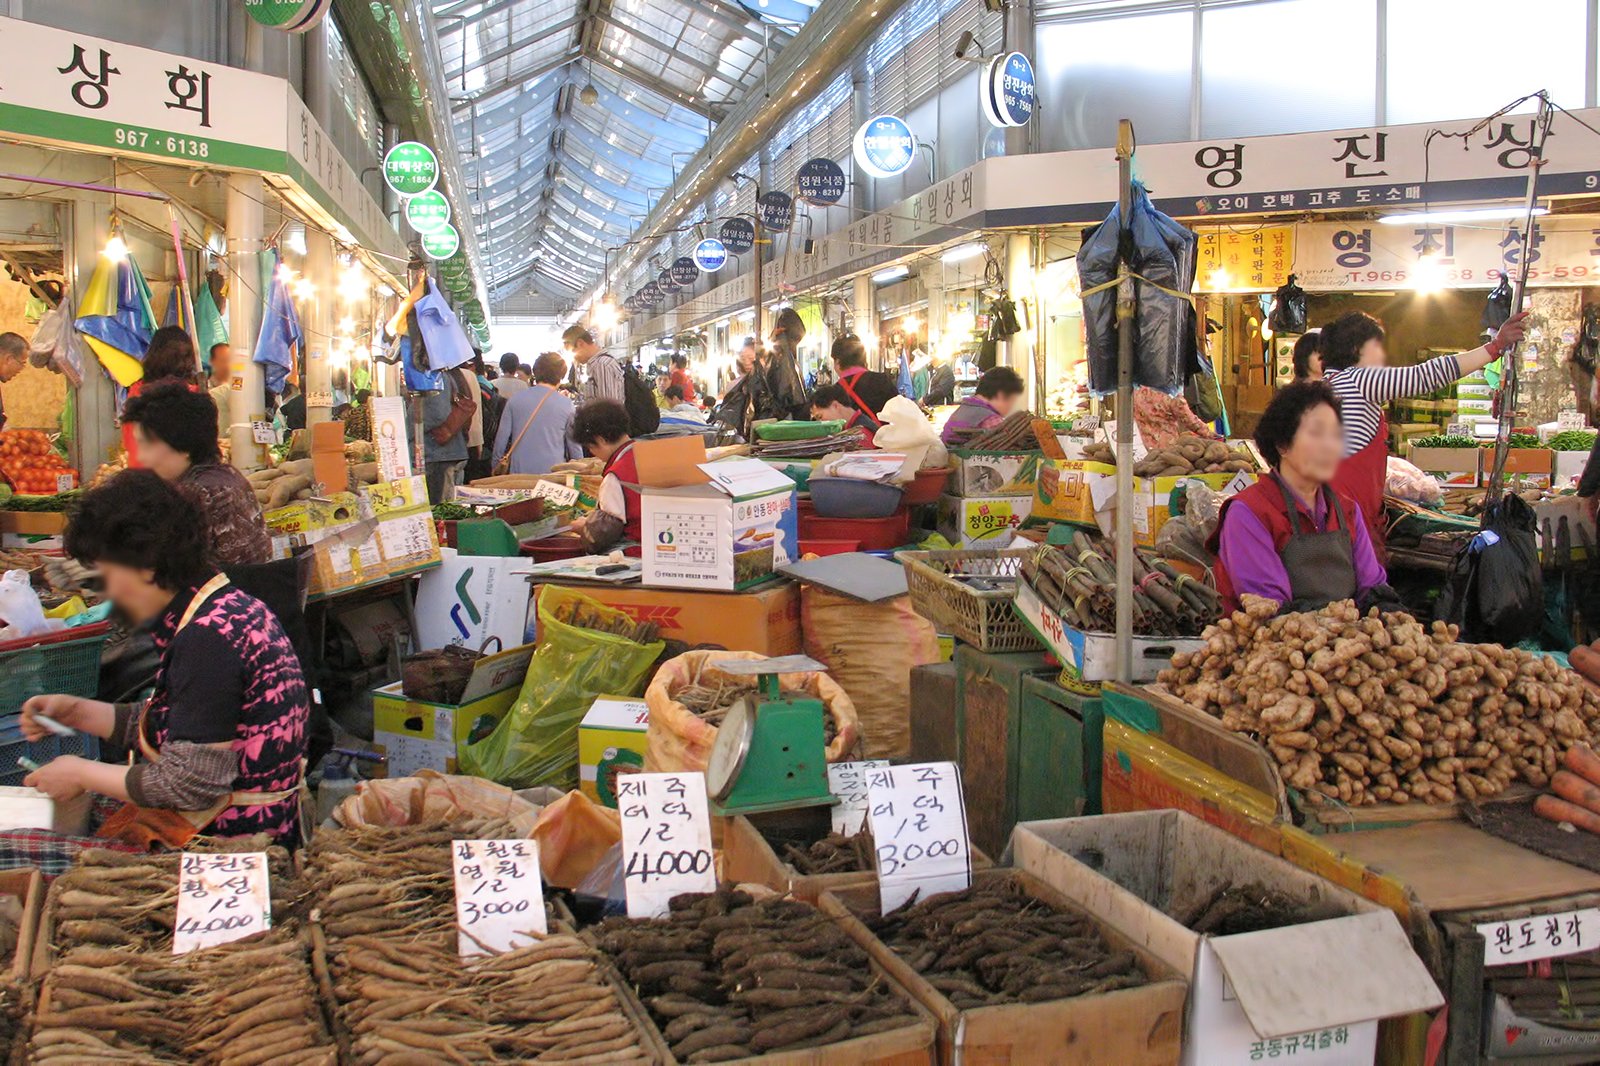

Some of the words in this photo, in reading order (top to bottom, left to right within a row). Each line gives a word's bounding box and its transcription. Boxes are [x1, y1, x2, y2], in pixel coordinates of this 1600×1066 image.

[57, 44, 213, 128] 상회
[1003, 73, 1034, 99] 영진상회
[800, 175, 844, 187] 정원식품
[913, 170, 974, 231] 한일상회
[1217, 196, 1249, 211] 오이
[1263, 193, 1295, 208] 호박
[1309, 191, 1342, 206] 고추
[848, 213, 893, 257] 정원식품
[969, 514, 1021, 530] 청양고추
[618, 777, 687, 798] 제주
[869, 767, 943, 790] 제주
[460, 860, 526, 880] 영월
[625, 849, 712, 884] 4.000
[1249, 1026, 1349, 1061] 공동규격출하
